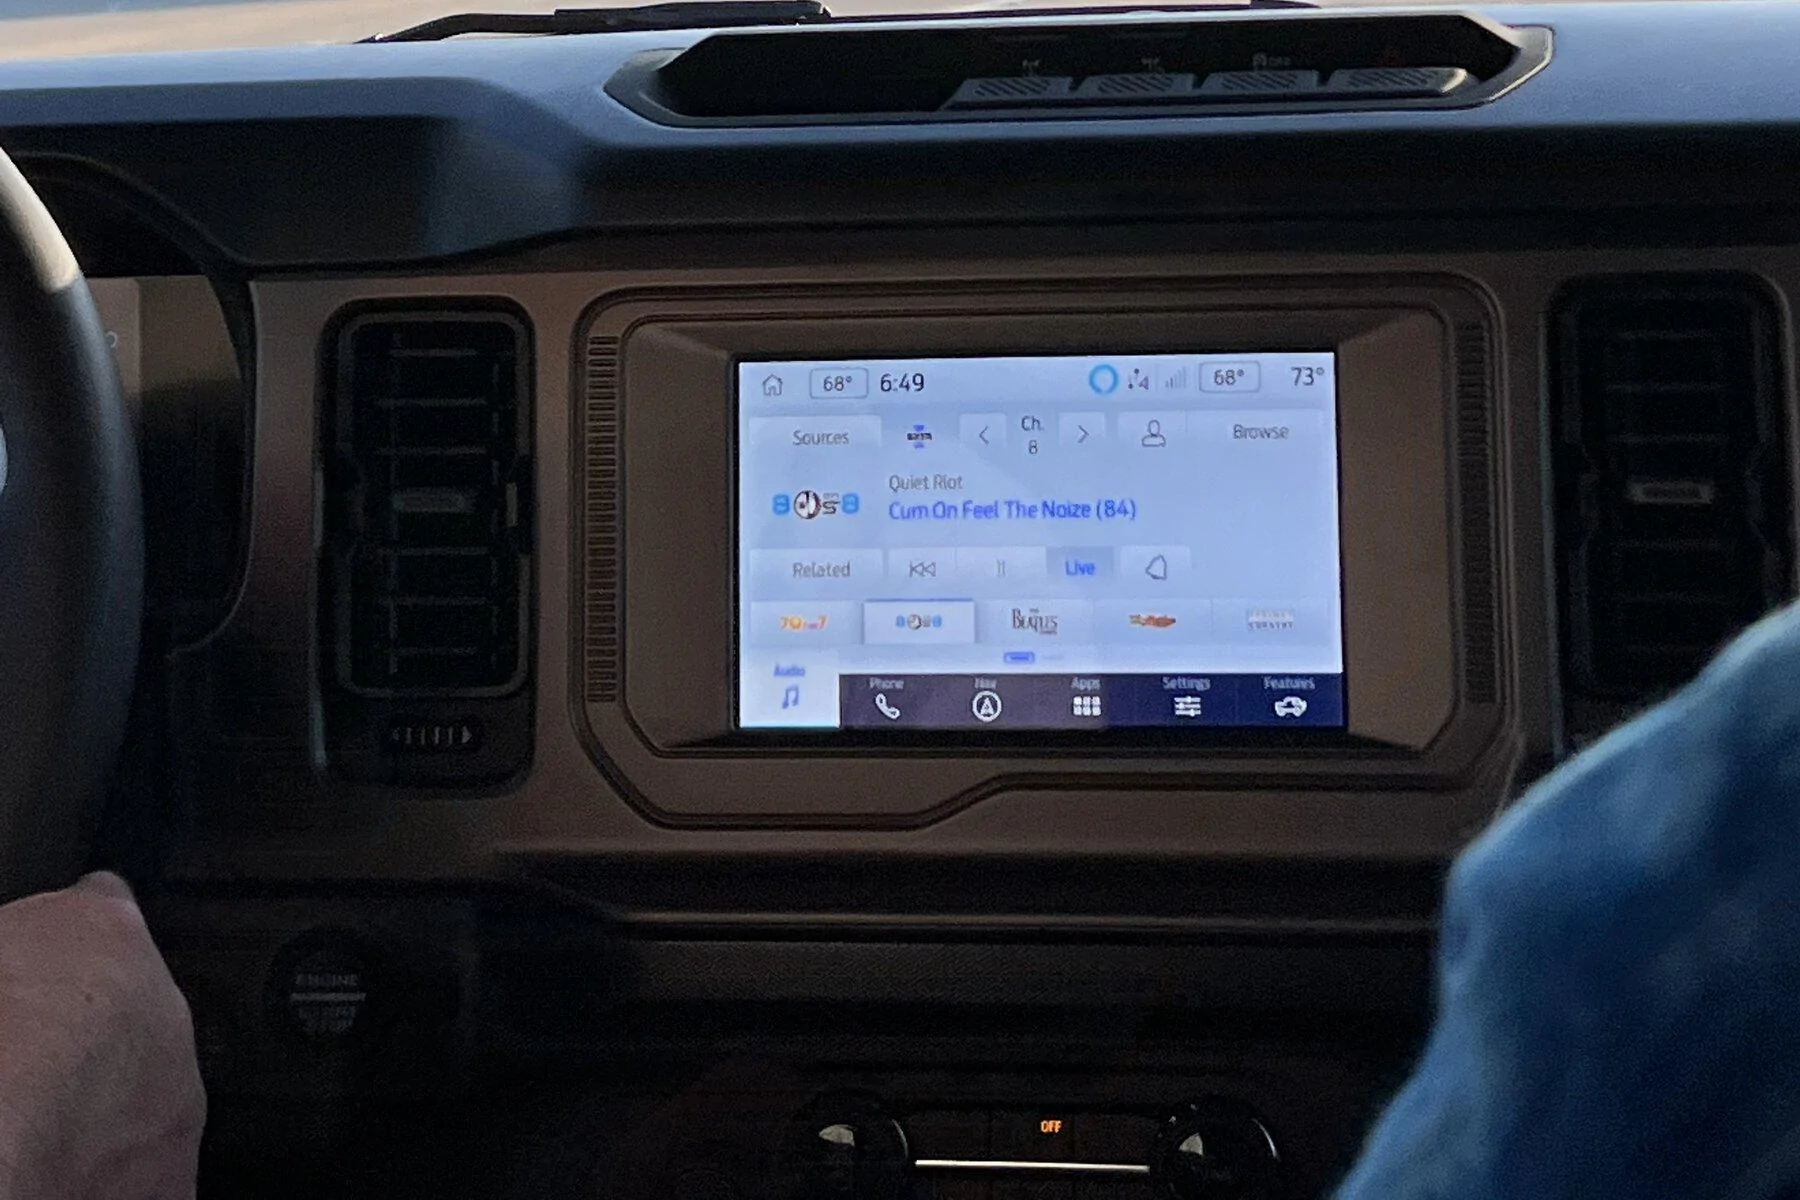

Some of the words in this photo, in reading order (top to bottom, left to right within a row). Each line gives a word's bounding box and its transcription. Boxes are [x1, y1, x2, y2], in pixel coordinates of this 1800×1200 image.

[879, 372, 925, 392] 6:49
[792, 429, 850, 446] Sources
[1233, 423, 1290, 440] Browse
[1028, 440, 1039, 455] 8
[889, 474, 929, 492] Quiet
[933, 474, 964, 490] Riot
[889, 502, 929, 519] Cum
[933, 501, 958, 519] On
[962, 501, 1000, 519] Feel
[1004, 501, 1039, 518] The
[1042, 500, 1092, 518] Noize
[1095, 499, 1137, 520] (84)
[792, 561, 851, 578] Related
[1065, 560, 1096, 576] Live
[773, 662, 806, 678] Audio
[869, 677, 904, 690] Phone
[1071, 677, 1100, 692] Apps
[1162, 676, 1211, 692] Settings
[1263, 676, 1316, 690] Features
[1040, 1119, 1062, 1133] OFF
